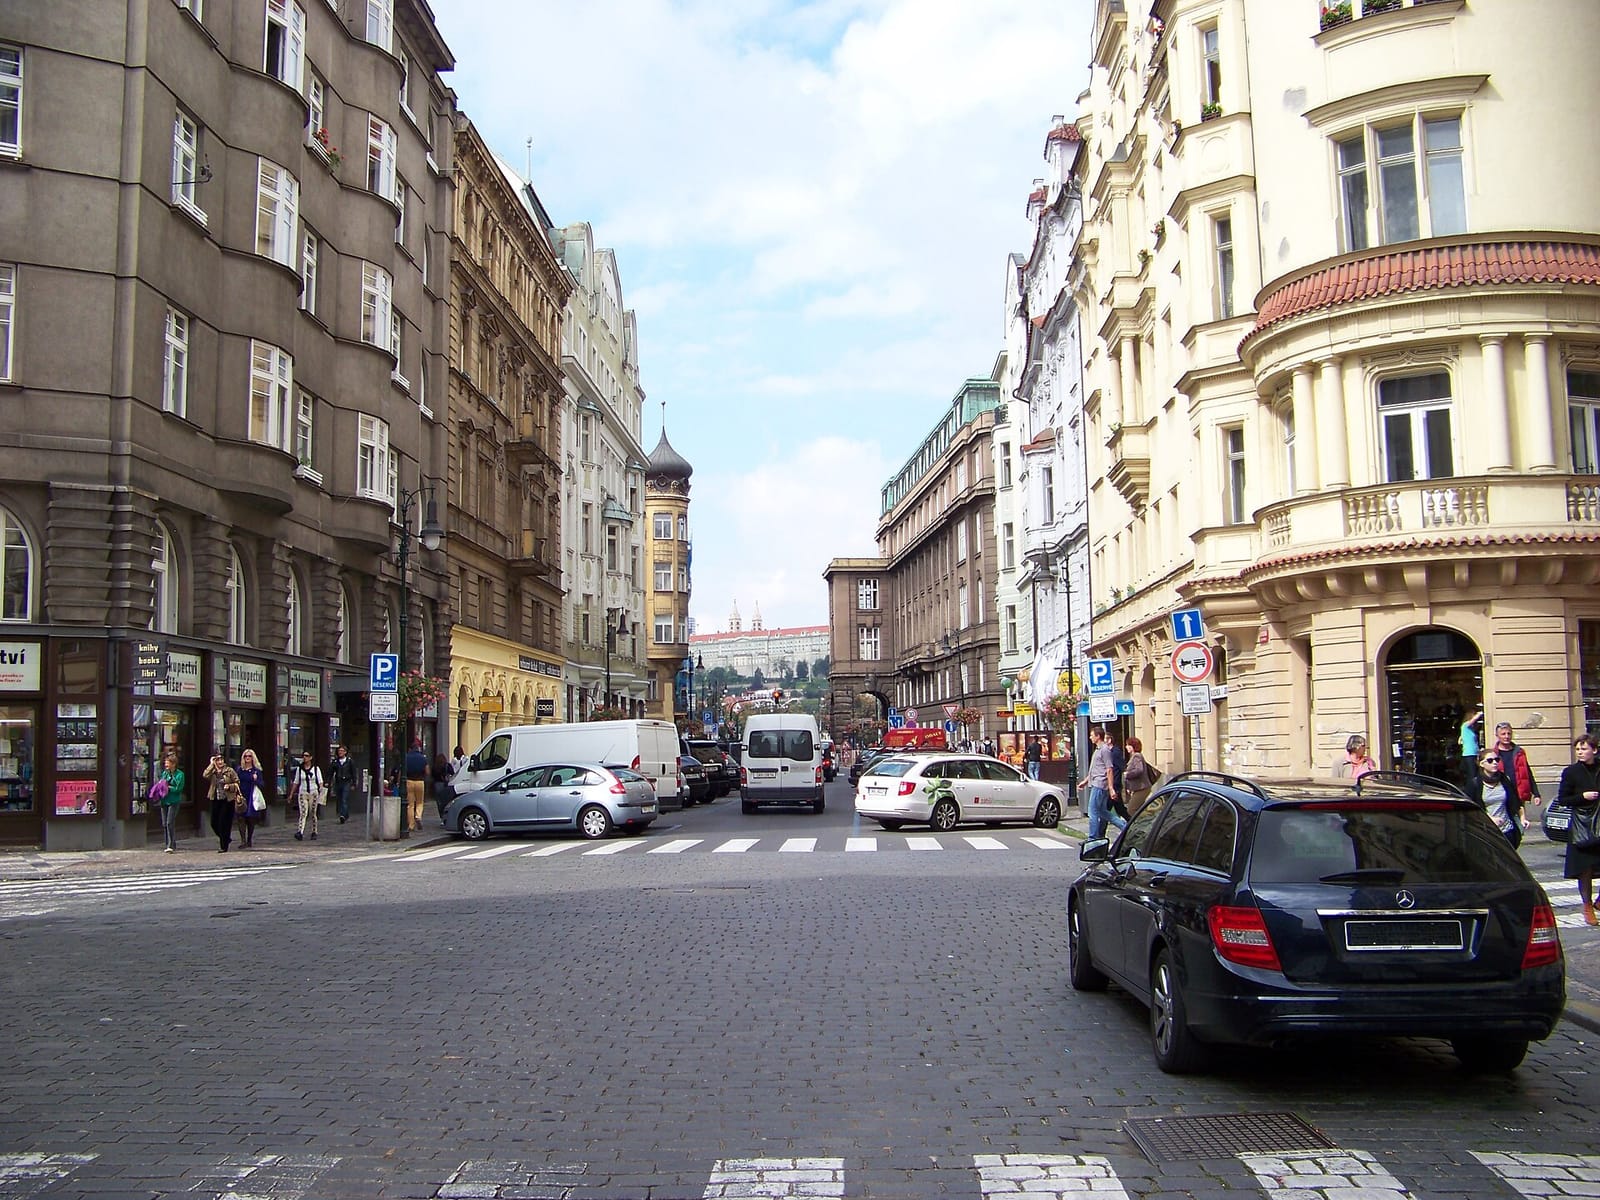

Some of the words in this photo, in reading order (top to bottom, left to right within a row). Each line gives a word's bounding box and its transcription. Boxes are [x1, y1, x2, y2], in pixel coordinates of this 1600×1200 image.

[139, 644, 159, 653] knihy
[138, 656, 160, 665] books
[141, 669, 157, 678] libri
[376, 658, 393, 681] P
[1091, 663, 1108, 684] P
[704, 713, 711, 721] P
